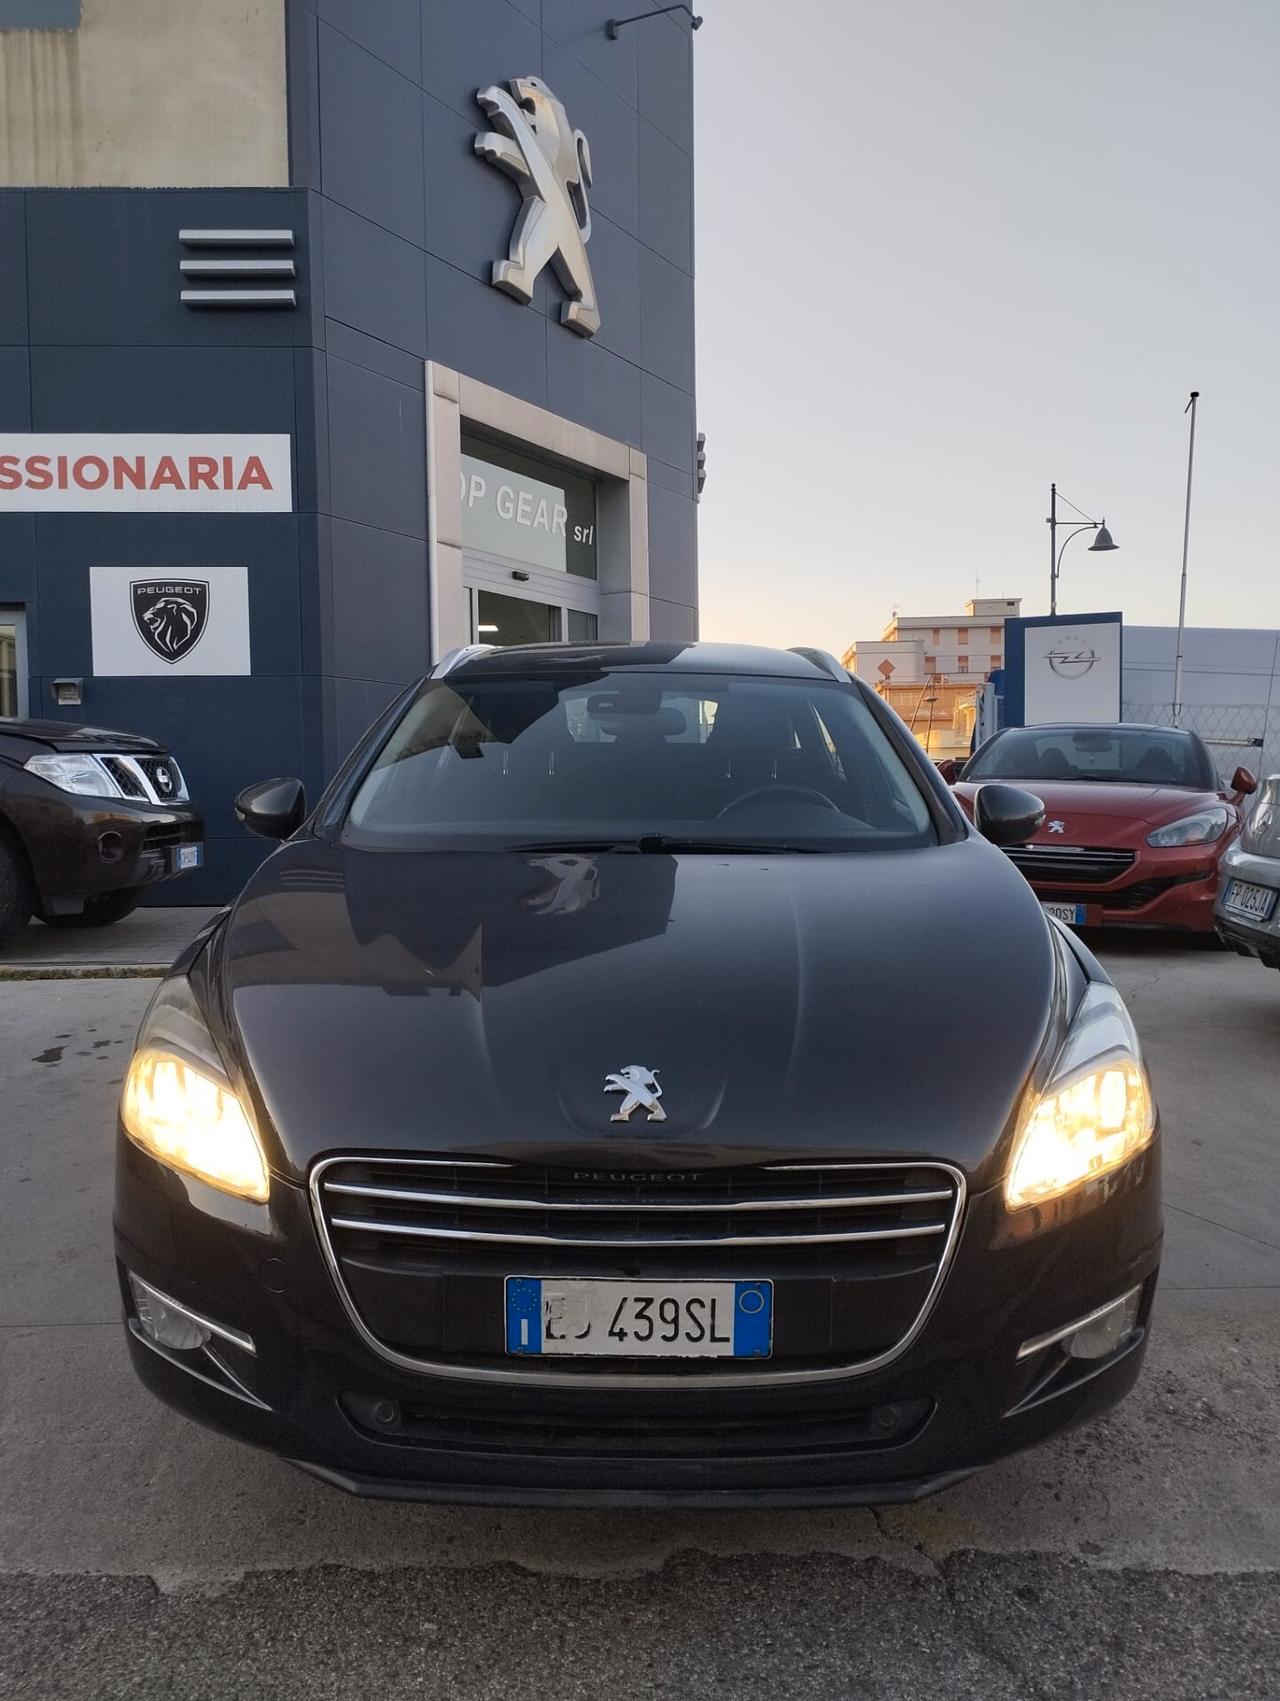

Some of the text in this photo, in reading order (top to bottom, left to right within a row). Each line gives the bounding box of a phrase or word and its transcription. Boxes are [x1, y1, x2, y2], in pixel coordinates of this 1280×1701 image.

[0, 455, 273, 490] SSIONARIA
[496, 485, 568, 537] GEAR
[573, 525, 594, 545] srl
[137, 586, 202, 595] PEUGEOT
[574, 1171, 704, 1181] PEUGEOT
[608, 1296, 731, 1343] 439SL
